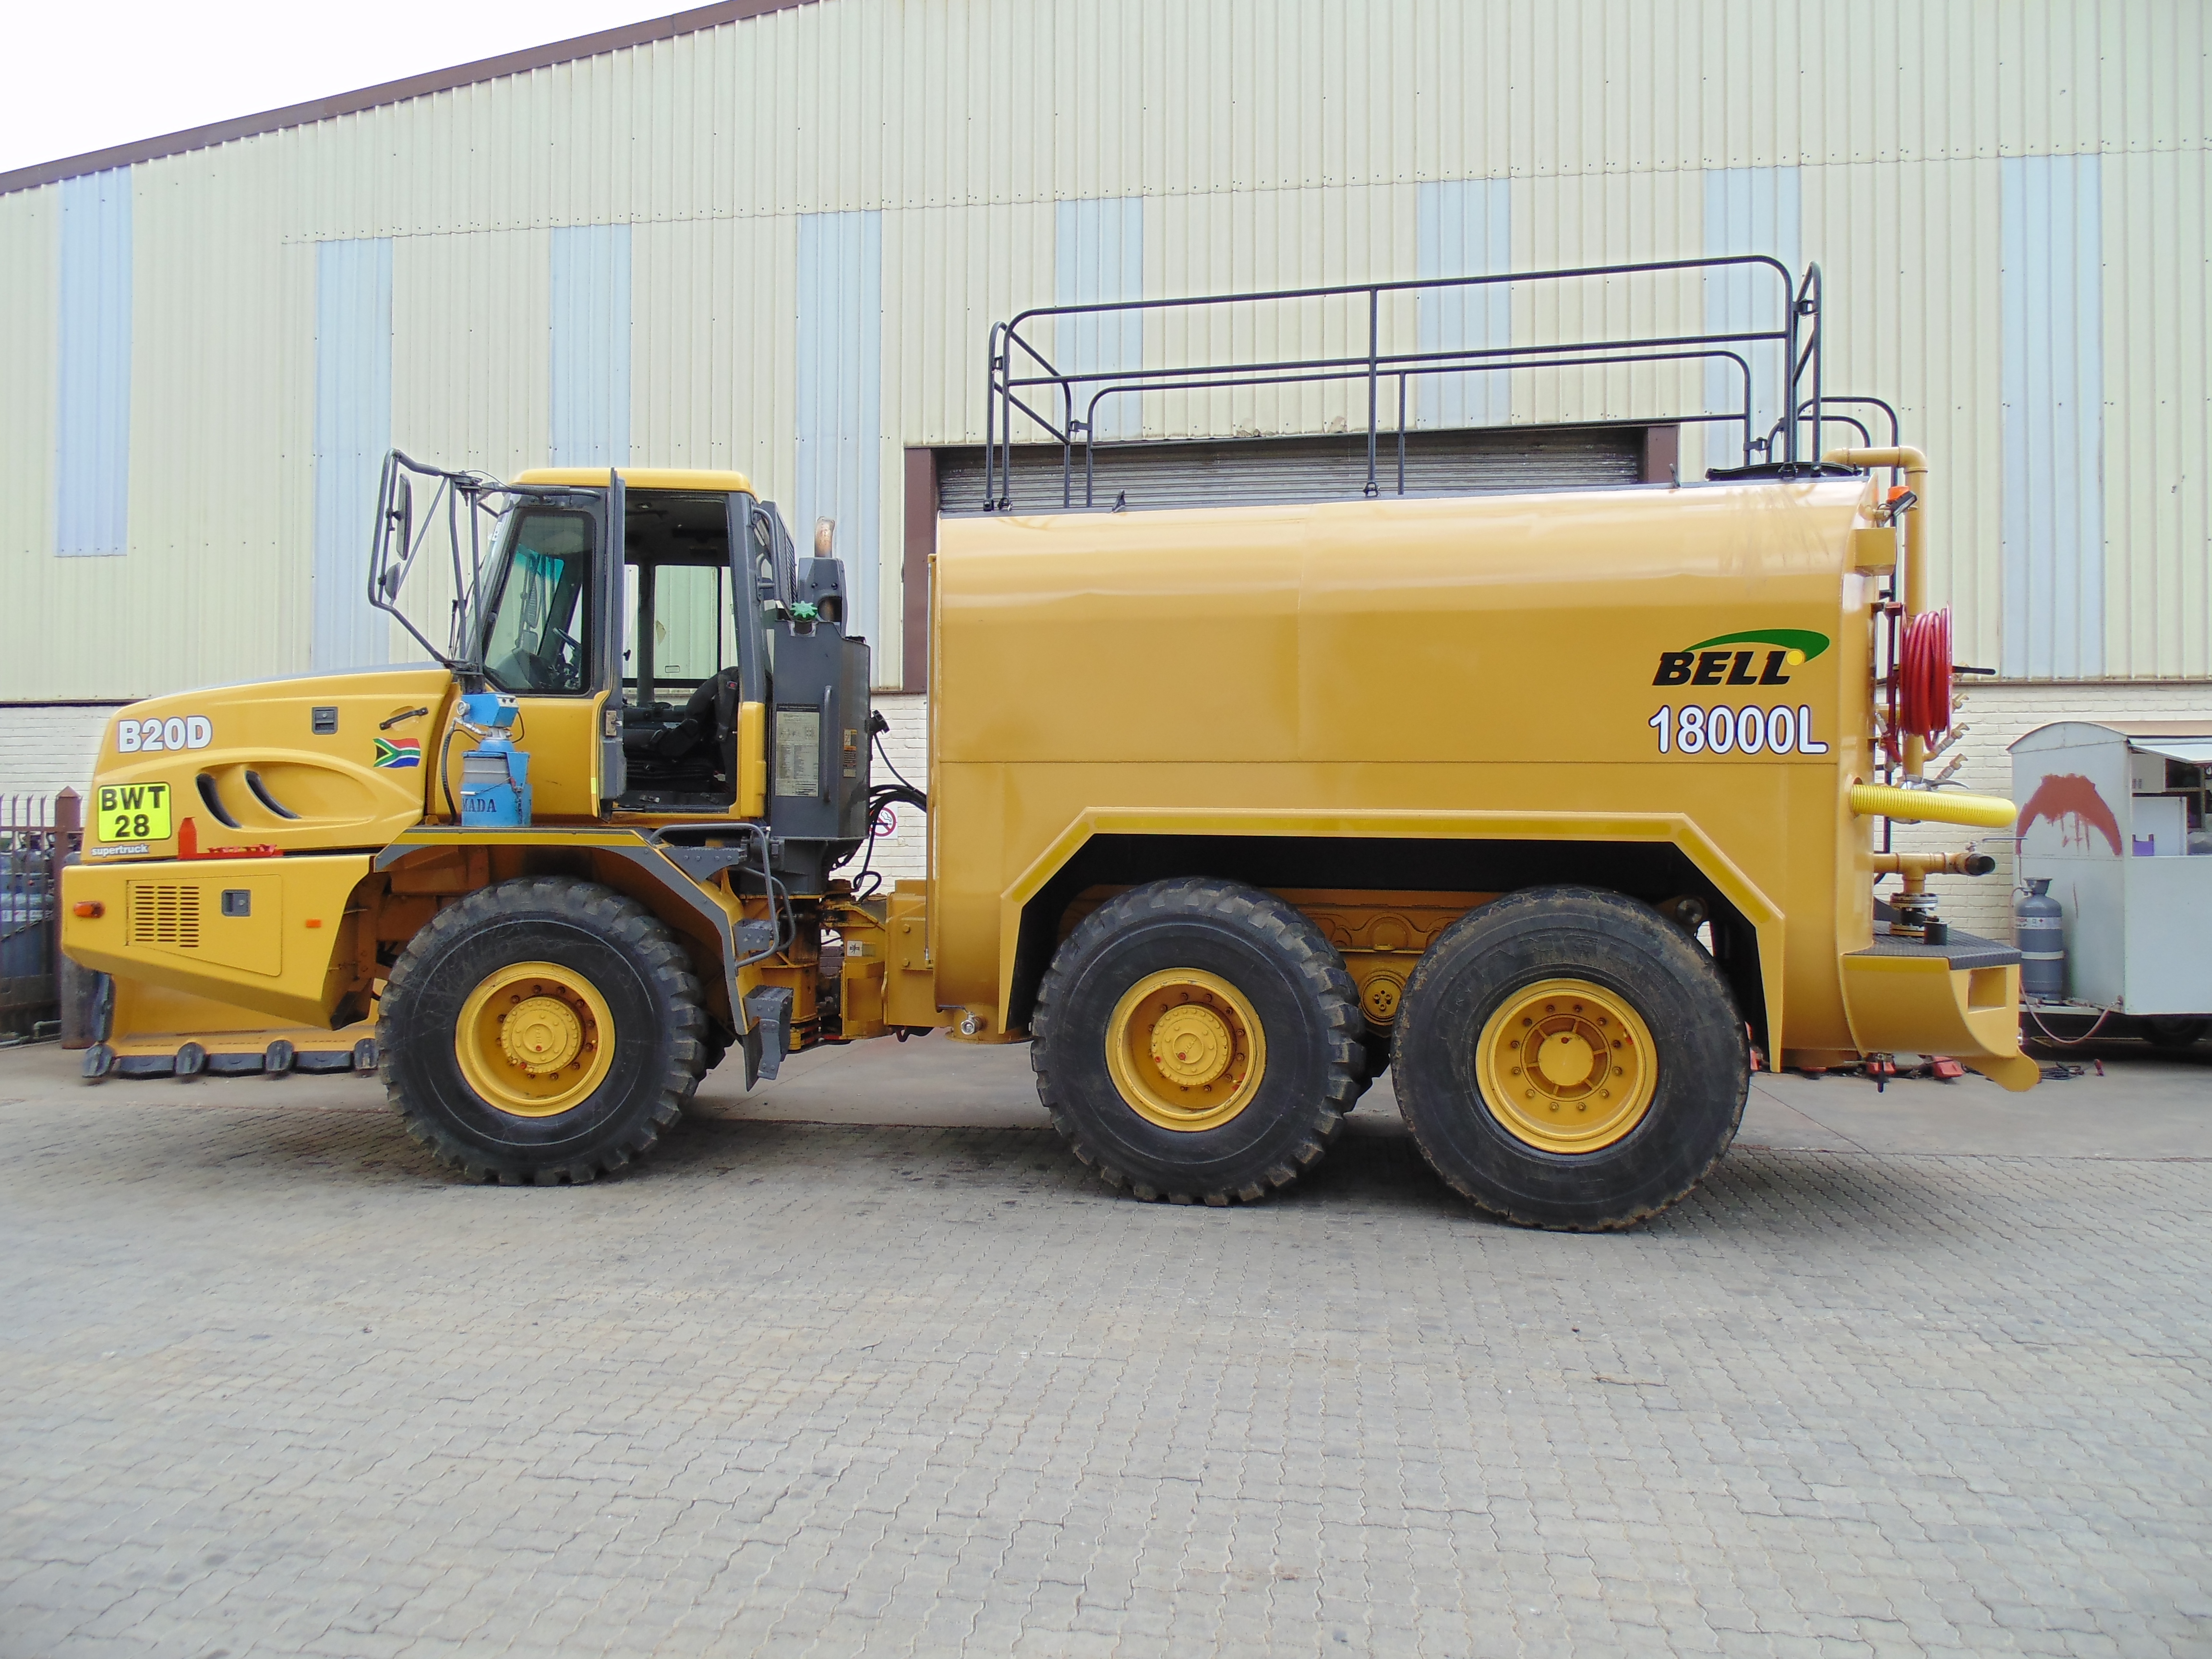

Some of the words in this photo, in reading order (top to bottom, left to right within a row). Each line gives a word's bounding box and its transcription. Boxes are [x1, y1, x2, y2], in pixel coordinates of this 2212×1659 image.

[1651, 650, 1791, 685] BELL
[118, 715, 213, 753] B20D
[1648, 704, 1829, 755] 18000L
[101, 785, 166, 811] BWT
[114, 814, 150, 838] 28
[91, 843, 150, 857] supertruck
